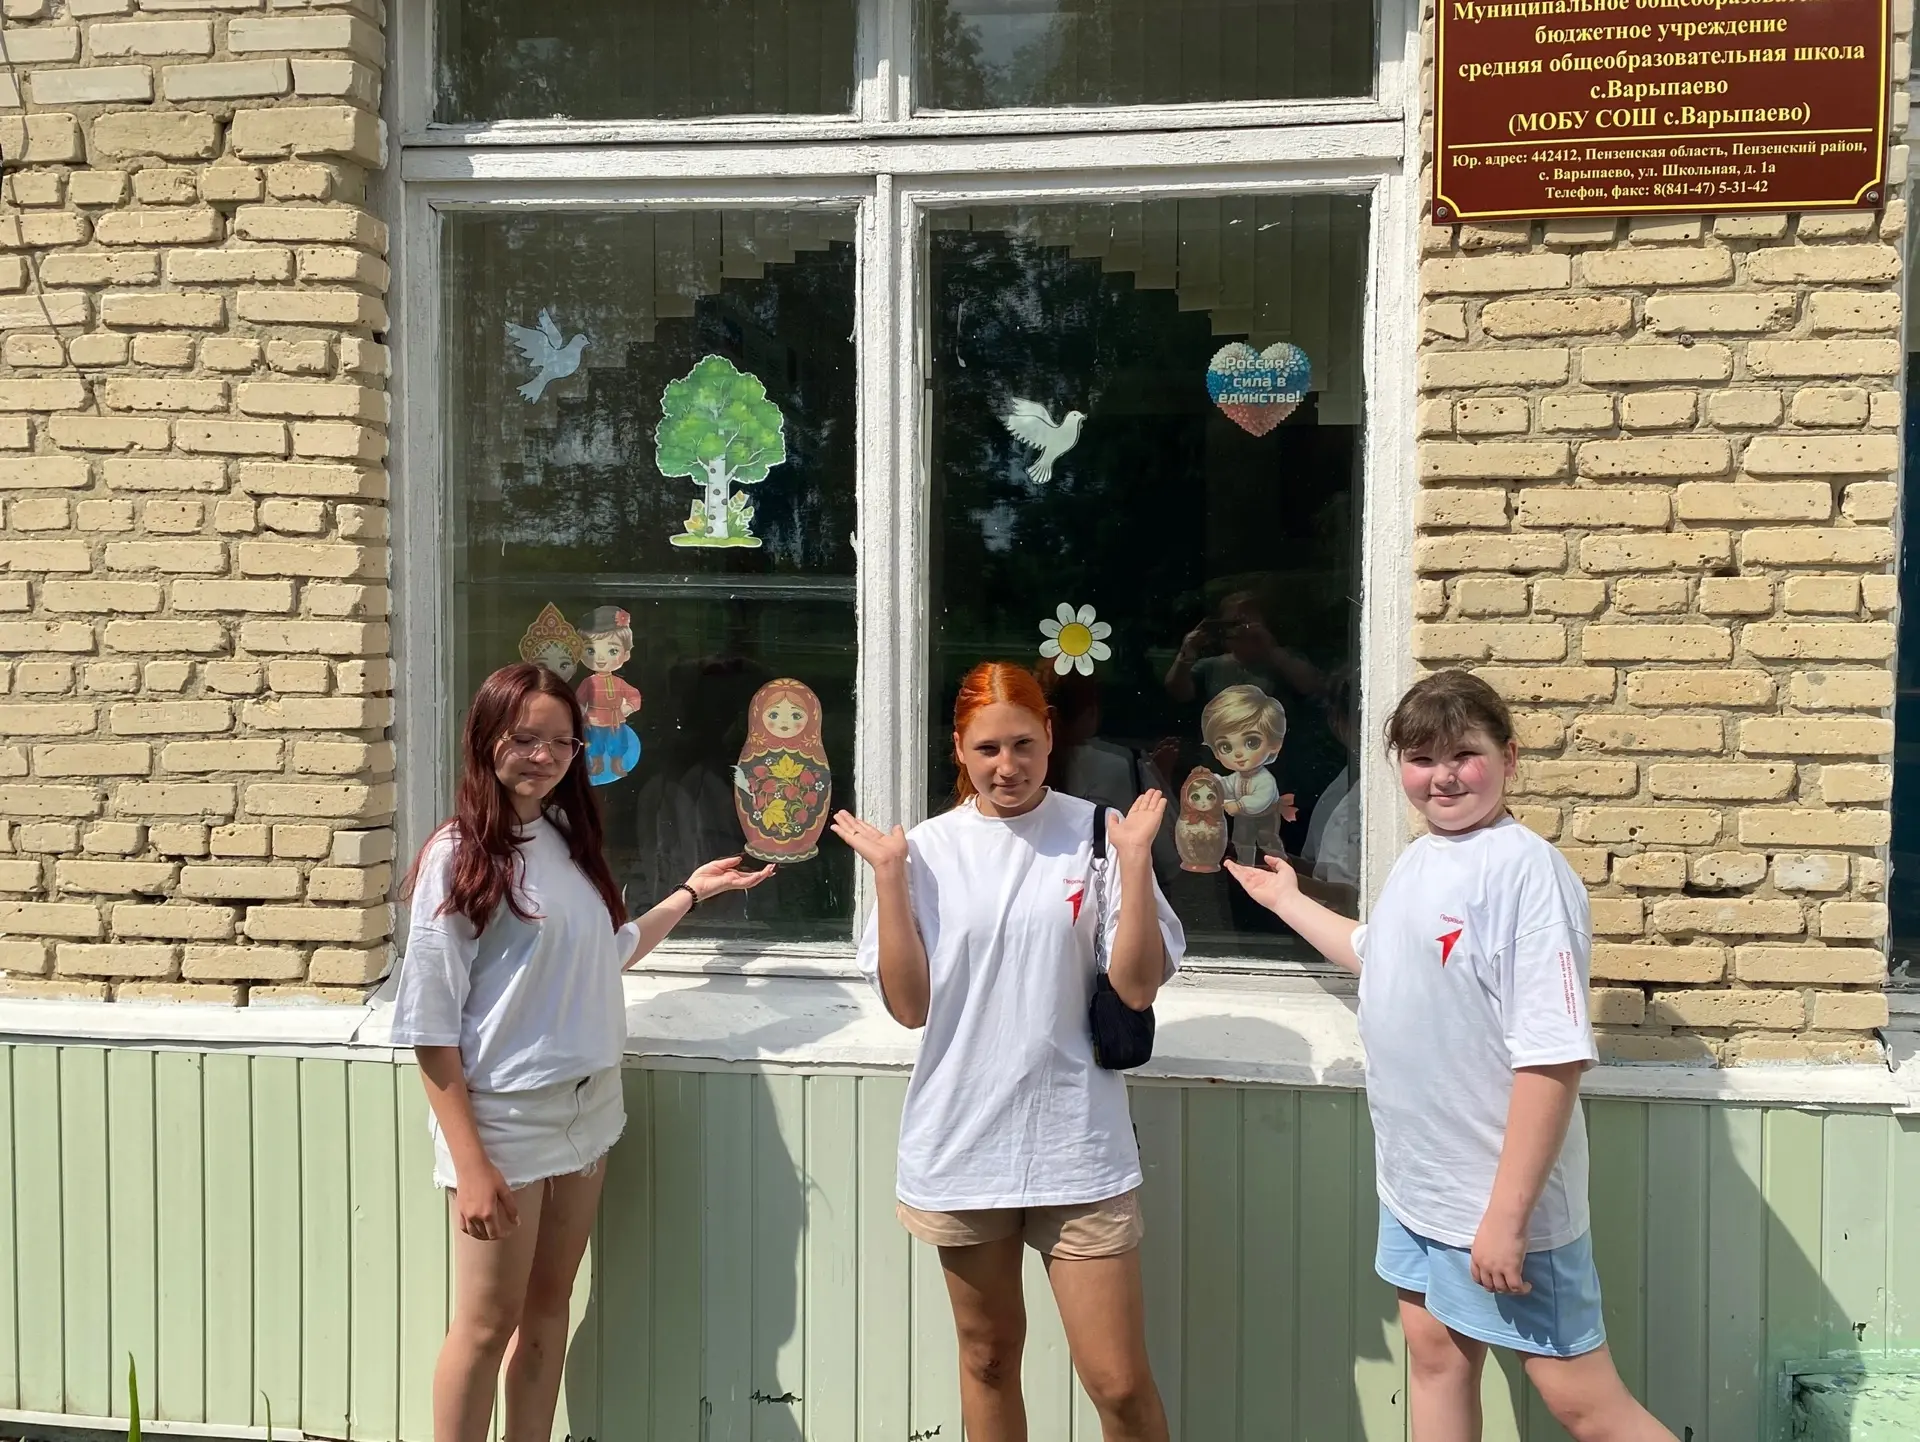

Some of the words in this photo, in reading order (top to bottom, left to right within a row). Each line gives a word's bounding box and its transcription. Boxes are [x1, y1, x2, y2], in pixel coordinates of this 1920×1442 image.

[1454, 0, 1629, 23] Муниципальное
[1536, 25, 1651, 44] бюджетное
[1658, 19, 1787, 42] учреждение
[1459, 60, 1542, 81] средняя
[1550, 48, 1786, 72] общеобразовательная
[1794, 46, 1864, 60] школа
[1591, 80, 1728, 102] с.Варыпаево
[1509, 111, 1589, 136] (МОБУ
[1596, 108, 1656, 127] СОШ
[1664, 103, 1811, 131] с.Варыпаево)
[1452, 154, 1482, 169] Юр.
[1485, 154, 1528, 168] адрес:
[1531, 148, 1582, 163] 442412,
[1585, 148, 1666, 160] Пензенская
[1669, 144, 1728, 158] область,
[1732, 140, 1817, 156] Пензенский
[1820, 139, 1867, 156] район,
[1538, 171, 1550, 181] с.
[1553, 168, 1635, 183] Варыпаево,
[1637, 167, 1658, 181] ул.
[1662, 164, 1741, 177] Школьная,
[1743, 164, 1757, 175] д.
[1761, 161, 1776, 173] 1а
[1544, 185, 1608, 201] Телефон,
[1611, 184, 1650, 200] факс:
[1653, 181, 1715, 198] 8(841-47)
[1718, 180, 1768, 194] 5-31-42
[1225, 357, 1284, 369] Россия
[1233, 377, 1272, 387] сила
[1277, 377, 1287, 387] в
[1218, 391, 1300, 404] единстве!
